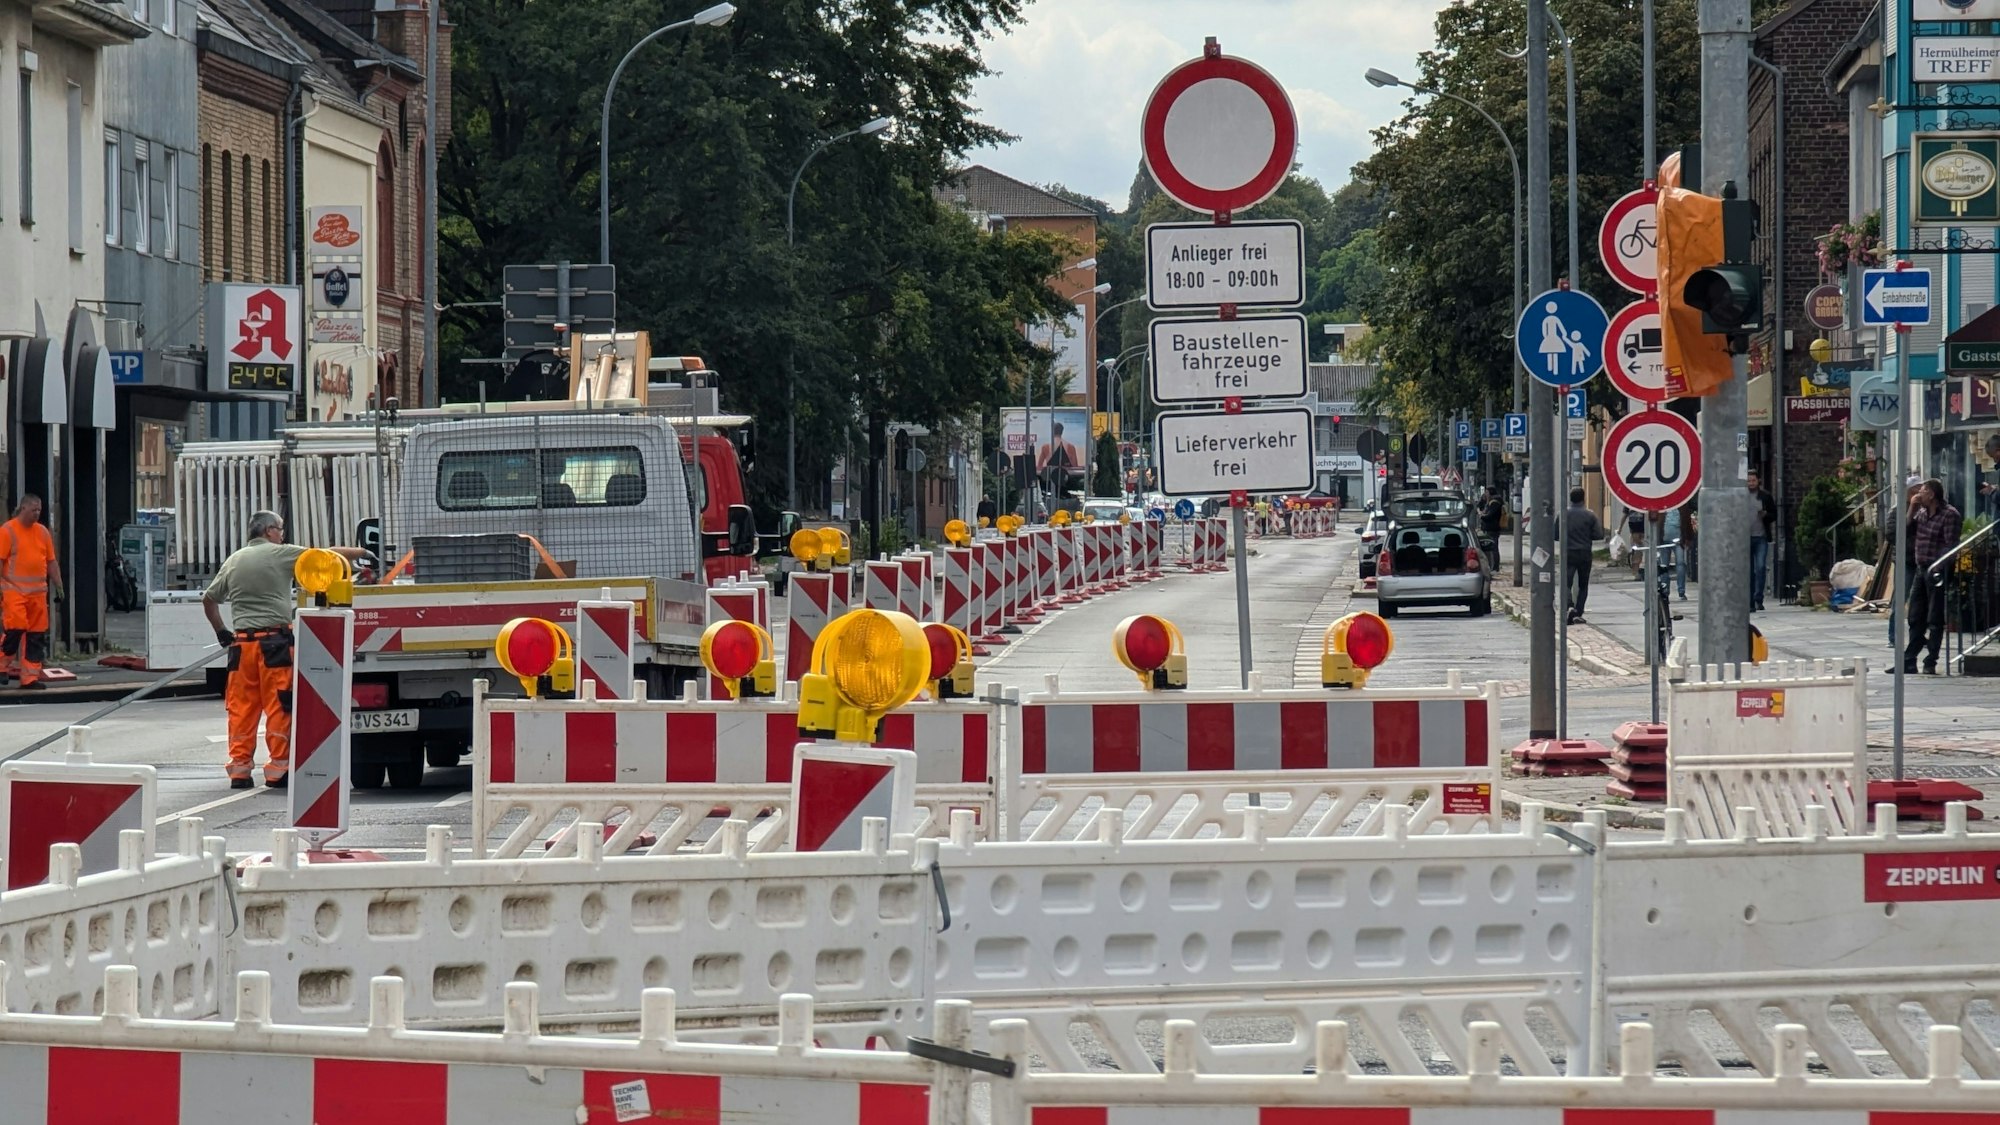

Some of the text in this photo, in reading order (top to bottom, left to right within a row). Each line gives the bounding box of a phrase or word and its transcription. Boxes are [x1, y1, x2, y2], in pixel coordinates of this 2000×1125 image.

[1920, 47, 2000, 57] Hermülheimer
[1928, 59, 1992, 73] TREFF
[1171, 243, 1268, 265] Anlieger frei
[1166, 271, 1205, 289] 18:00
[1816, 296, 1843, 307] COPY
[1882, 291, 1926, 304] Einbahnstraße
[1173, 332, 1289, 352] Baustellen-
[1182, 353, 1282, 371] fahrzeuge
[1214, 370, 1248, 388] frei
[1791, 399, 1850, 410] PASSBILDER
[1860, 395, 1899, 411] FAIX
[1809, 409, 1832, 421] sofort
[1175, 430, 1298, 454] Lieferverkehr
[1213, 458, 1247, 477] frei
[1625, 440, 1681, 485] 20
[1741, 697, 1767, 708] ZEPPELIN
[362, 713, 410, 727] VS 341
[1886, 866, 1984, 886] ZEPPELIN
